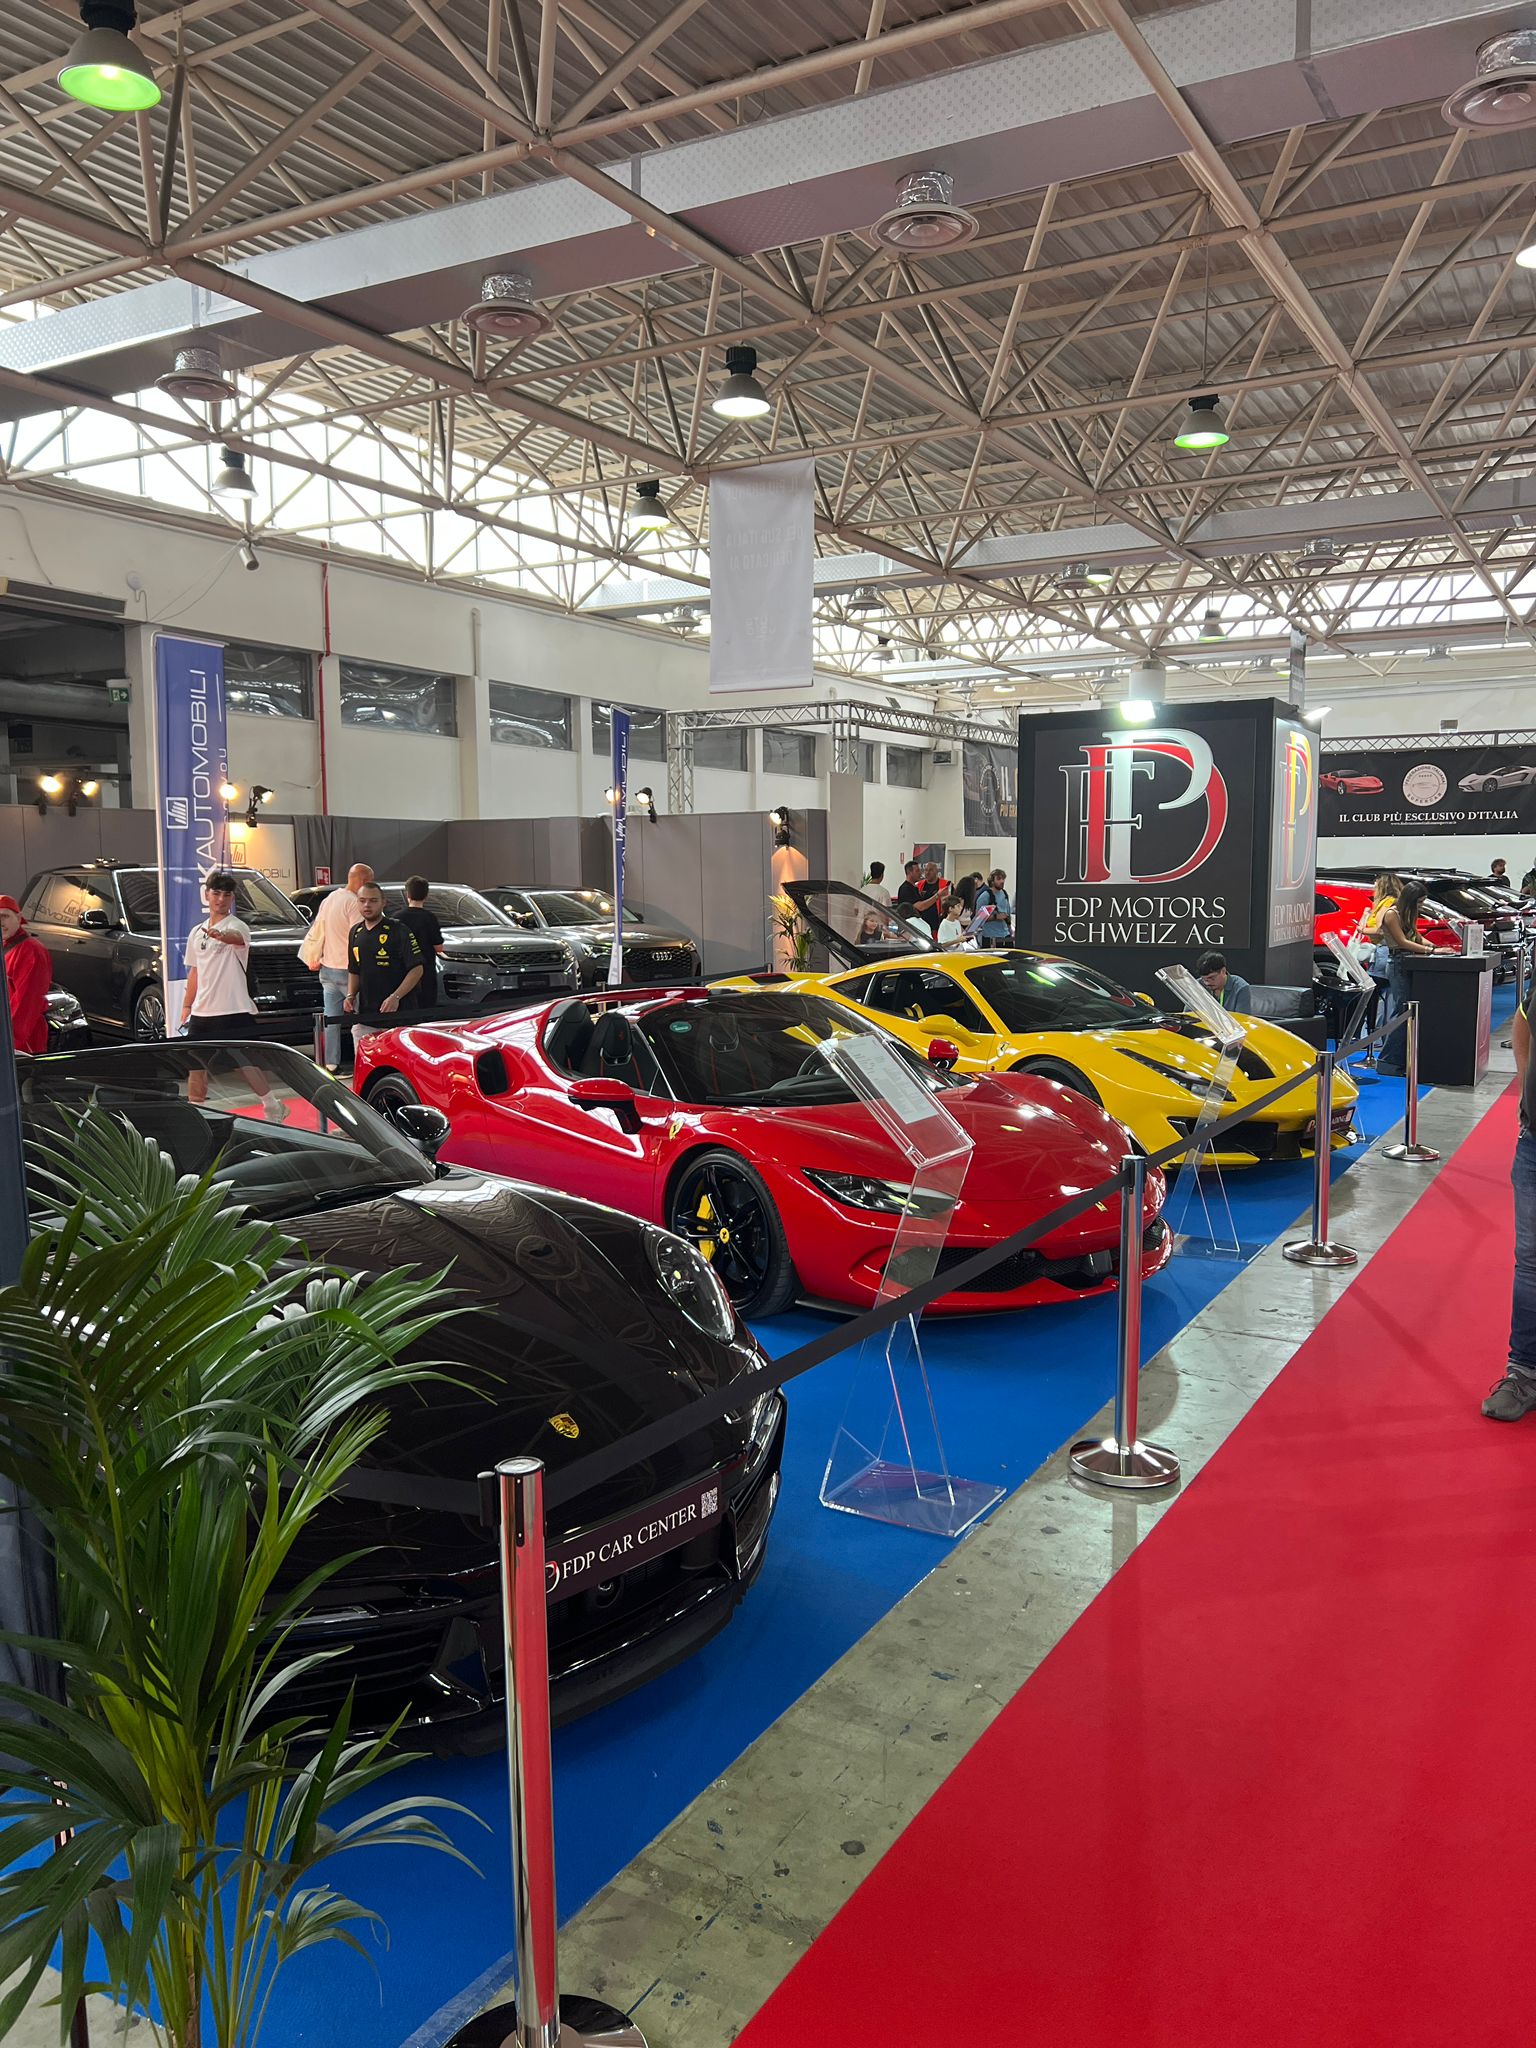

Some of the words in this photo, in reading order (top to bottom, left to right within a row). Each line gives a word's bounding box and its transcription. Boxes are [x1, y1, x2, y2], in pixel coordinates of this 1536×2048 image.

[1339, 814, 1350, 823] IL
[1352, 813, 1381, 823] CLUB
[1383, 810, 1402, 822] PIÙ
[1405, 811, 1466, 822] ESCLUSIVO
[1467, 810, 1519, 821] D'ITALIA
[1056, 896, 1102, 918] FDP
[1110, 896, 1227, 919] MOTORS
[1054, 922, 1177, 944] SCHWEIZ
[1184, 923, 1225, 945] AG
[562, 1550, 596, 1580] FDP
[598, 1533, 634, 1563] CAR
[637, 1503, 698, 1545] CENTER
